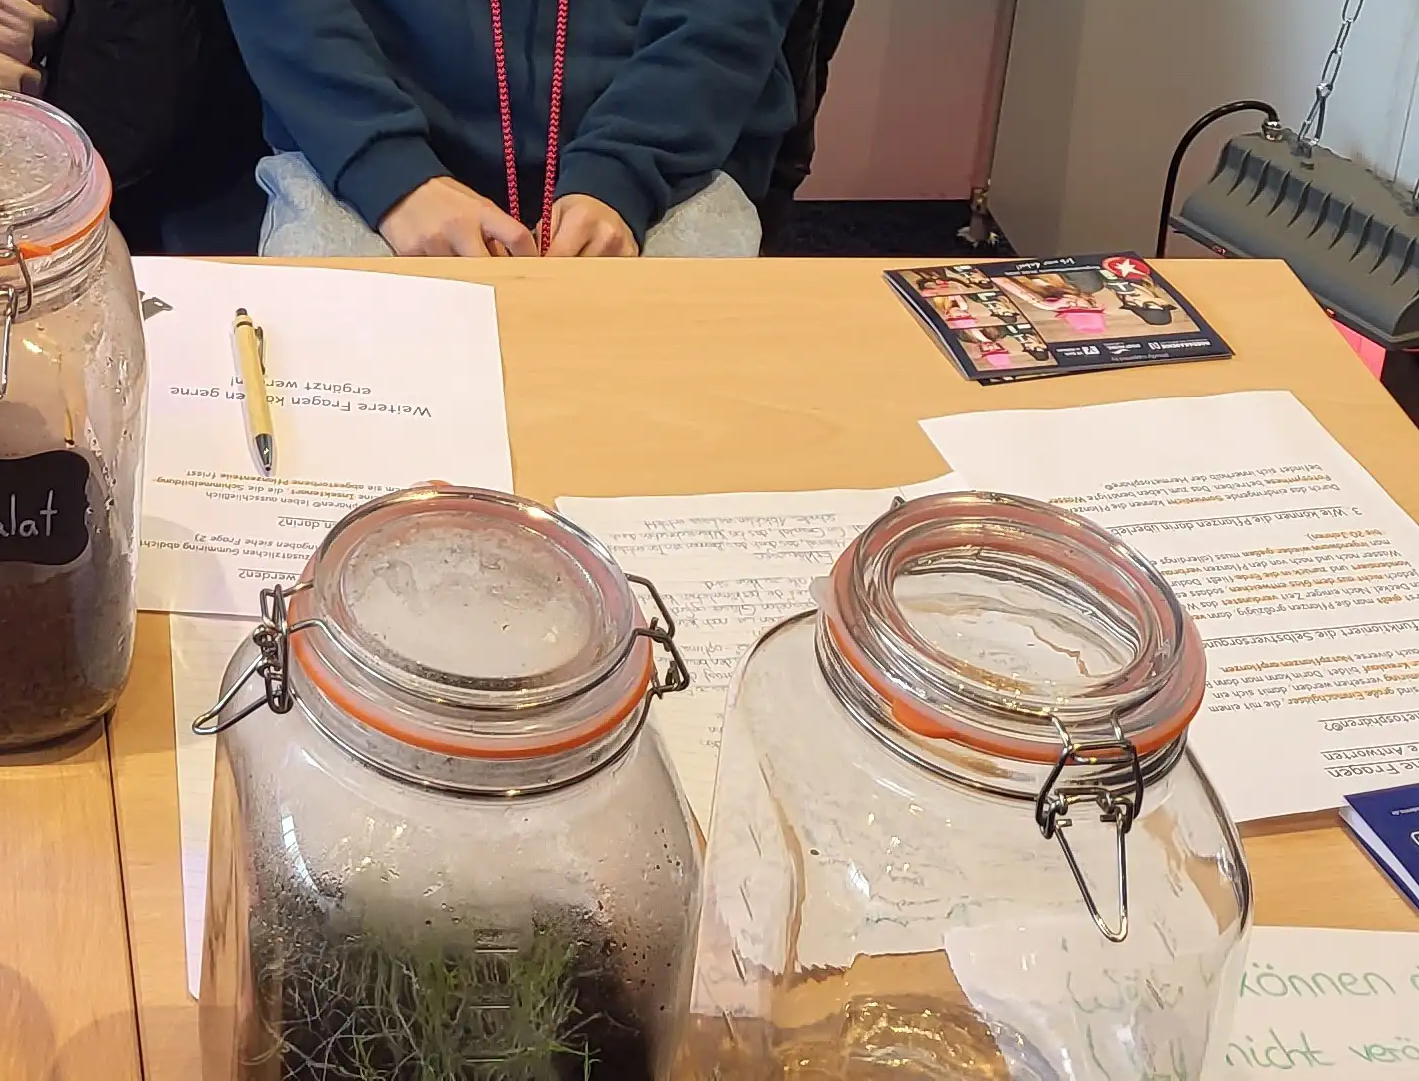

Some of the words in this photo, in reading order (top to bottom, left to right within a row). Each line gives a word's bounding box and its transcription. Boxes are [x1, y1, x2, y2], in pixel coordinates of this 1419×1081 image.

[169, 386, 221, 398] gerne
[304, 380, 371, 397] ergänzt
[291, 395, 352, 412] Fragen
[357, 402, 432, 418] Weitere
[247, 485, 265, 493] die
[267, 487, 284, 495] die
[280, 497, 310, 507] leben
[1274, 510, 1321, 521] können
[1319, 508, 1349, 518] Wie
[277, 518, 321, 530] darin?
[1195, 517, 1253, 529] Pflanzen
[1251, 516, 1272, 525] die
[1160, 522, 1195, 531] darin
[210, 535, 242, 546] Frage
[244, 538, 274, 548] siehe
[182, 542, 240, 556] Gummiring
[1362, 550, 1402, 559] Wasser
[1247, 560, 1268, 569] den
[1314, 555, 1335, 563] und
[1202, 562, 1250, 573] Pflanzen
[1328, 565, 1350, 573] und
[237, 570, 297, 581] werden?
[1288, 602, 1335, 611] Pflanzen
[1334, 599, 1351, 608] die
[1207, 611, 1233, 620] dann
[1340, 621, 1419, 637] funktioniert
[1315, 630, 1337, 641] die
[1353, 651, 1394, 663] diverse
[1241, 675, 1265, 684] man
[1264, 673, 1292, 683] kann
[1290, 669, 1324, 681] Darin
[1212, 678, 1240, 688] dann
[1333, 676, 1384, 690] versehen
[1212, 691, 1230, 700] ein
[1232, 690, 1255, 700] sich
[1257, 686, 1288, 697] damit
[1207, 703, 1241, 713] einem
[1243, 701, 1263, 712] mit
[1263, 699, 1282, 710] die
[1322, 747, 1404, 762] Antworten
[1327, 764, 1401, 779] Fragen
